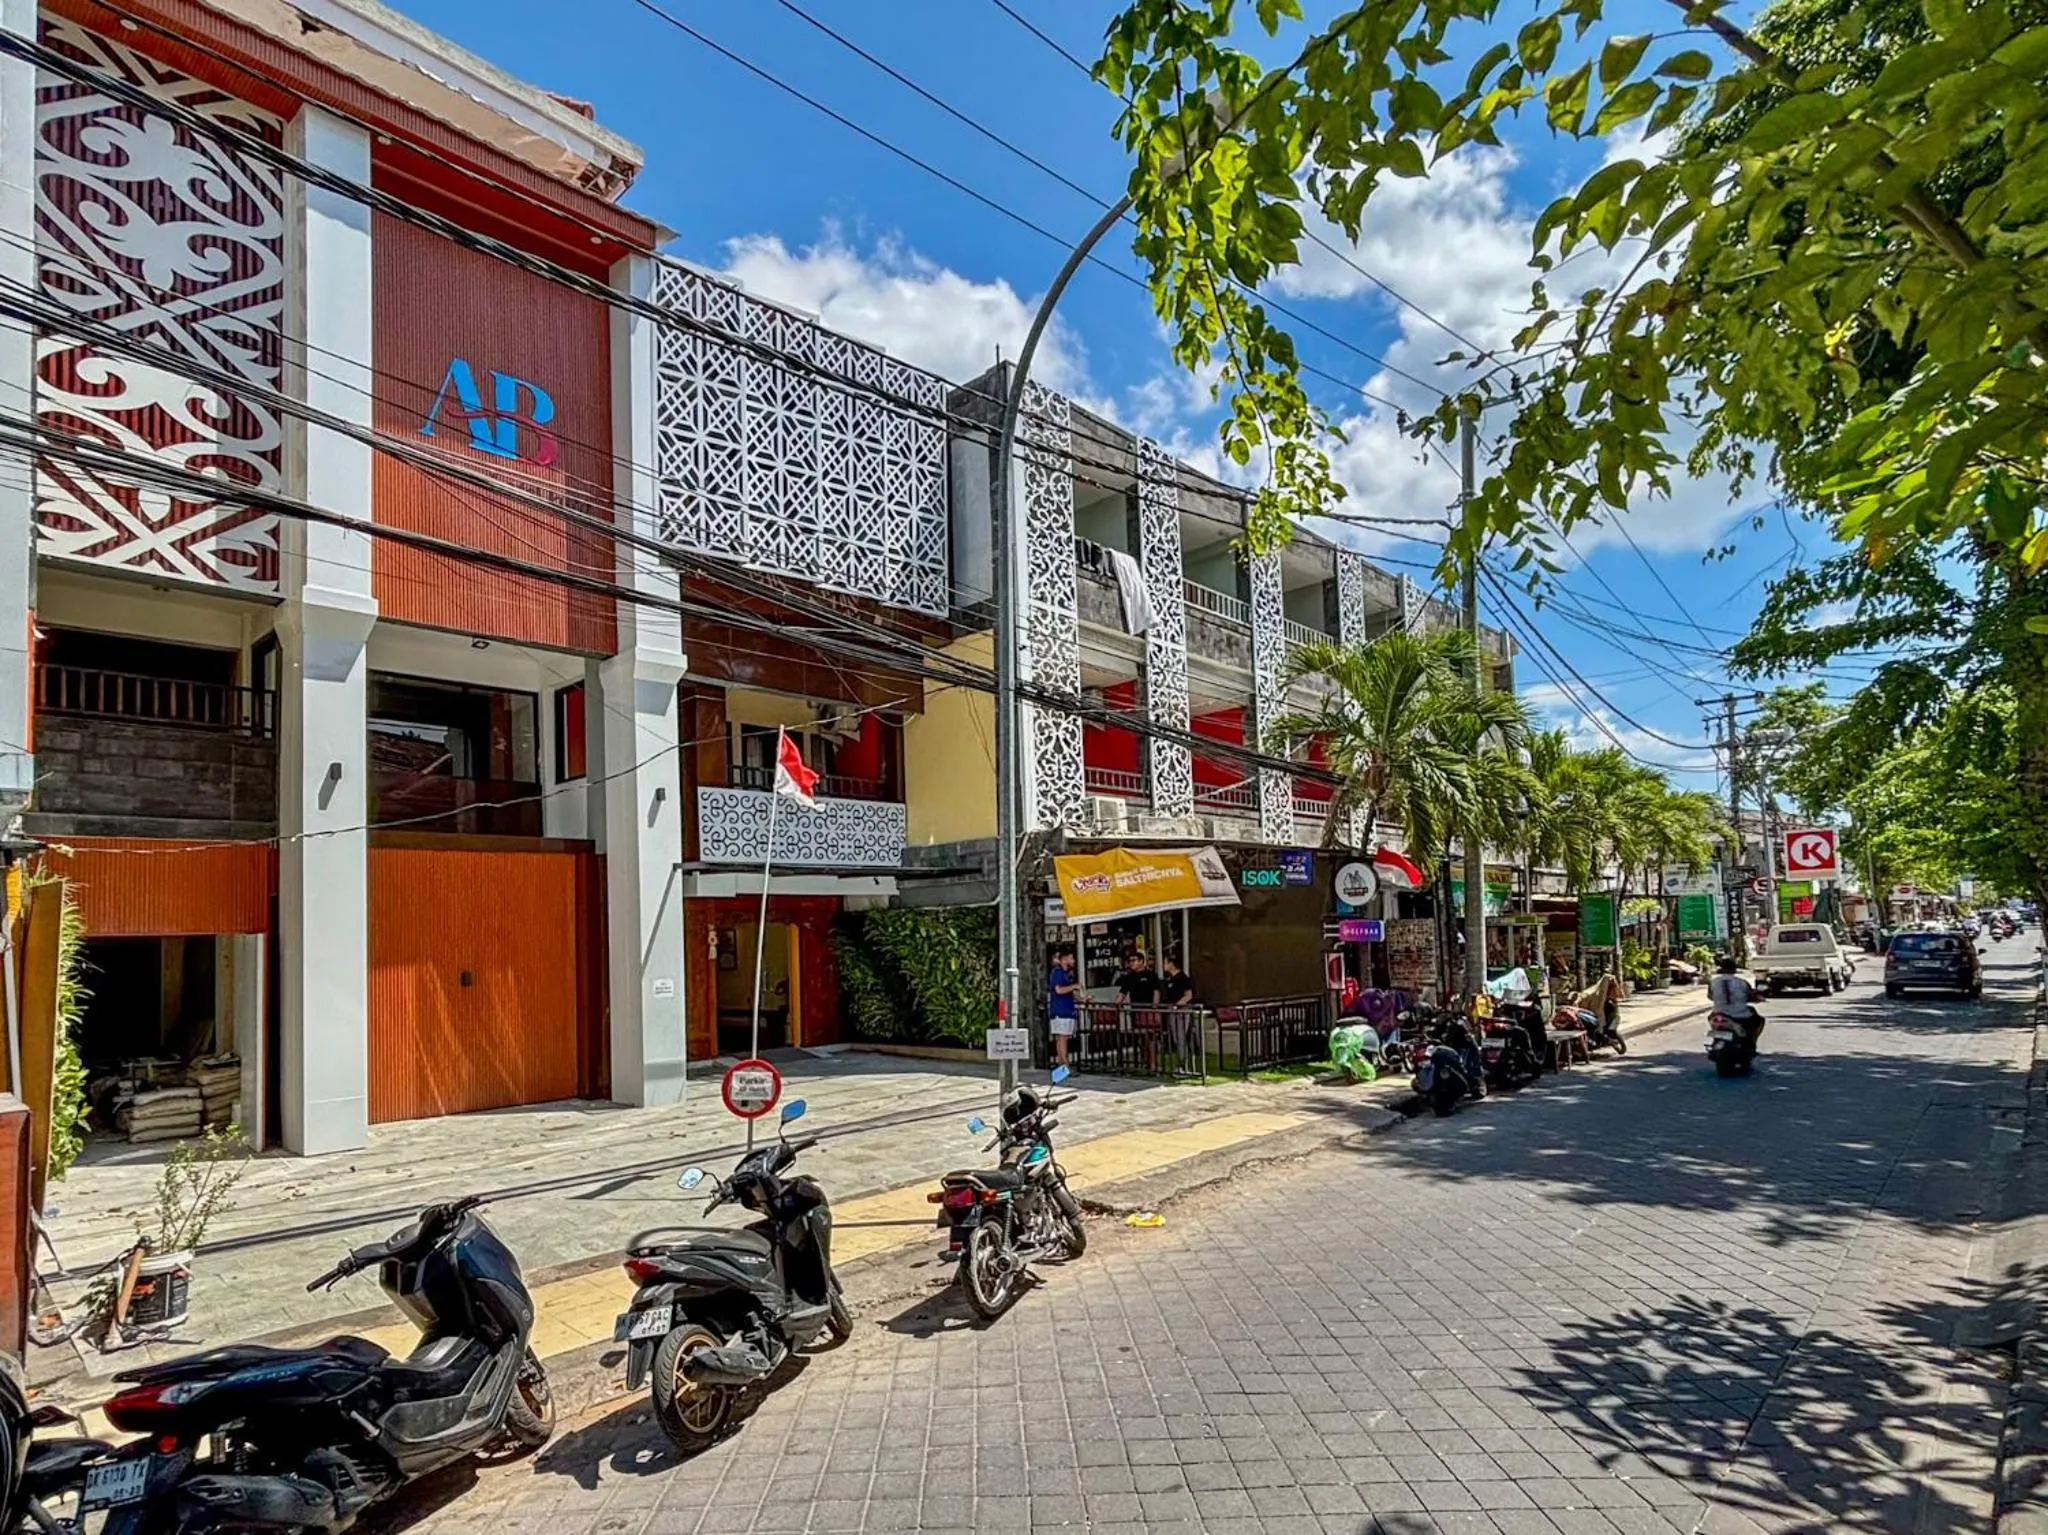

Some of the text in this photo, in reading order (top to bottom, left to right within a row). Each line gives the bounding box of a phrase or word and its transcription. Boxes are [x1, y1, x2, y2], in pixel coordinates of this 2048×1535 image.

[418, 356, 560, 466] AB
[1802, 842, 1824, 861] K
[1242, 870, 1281, 886] ISOK
[1728, 891, 1742, 934] TATTOO
